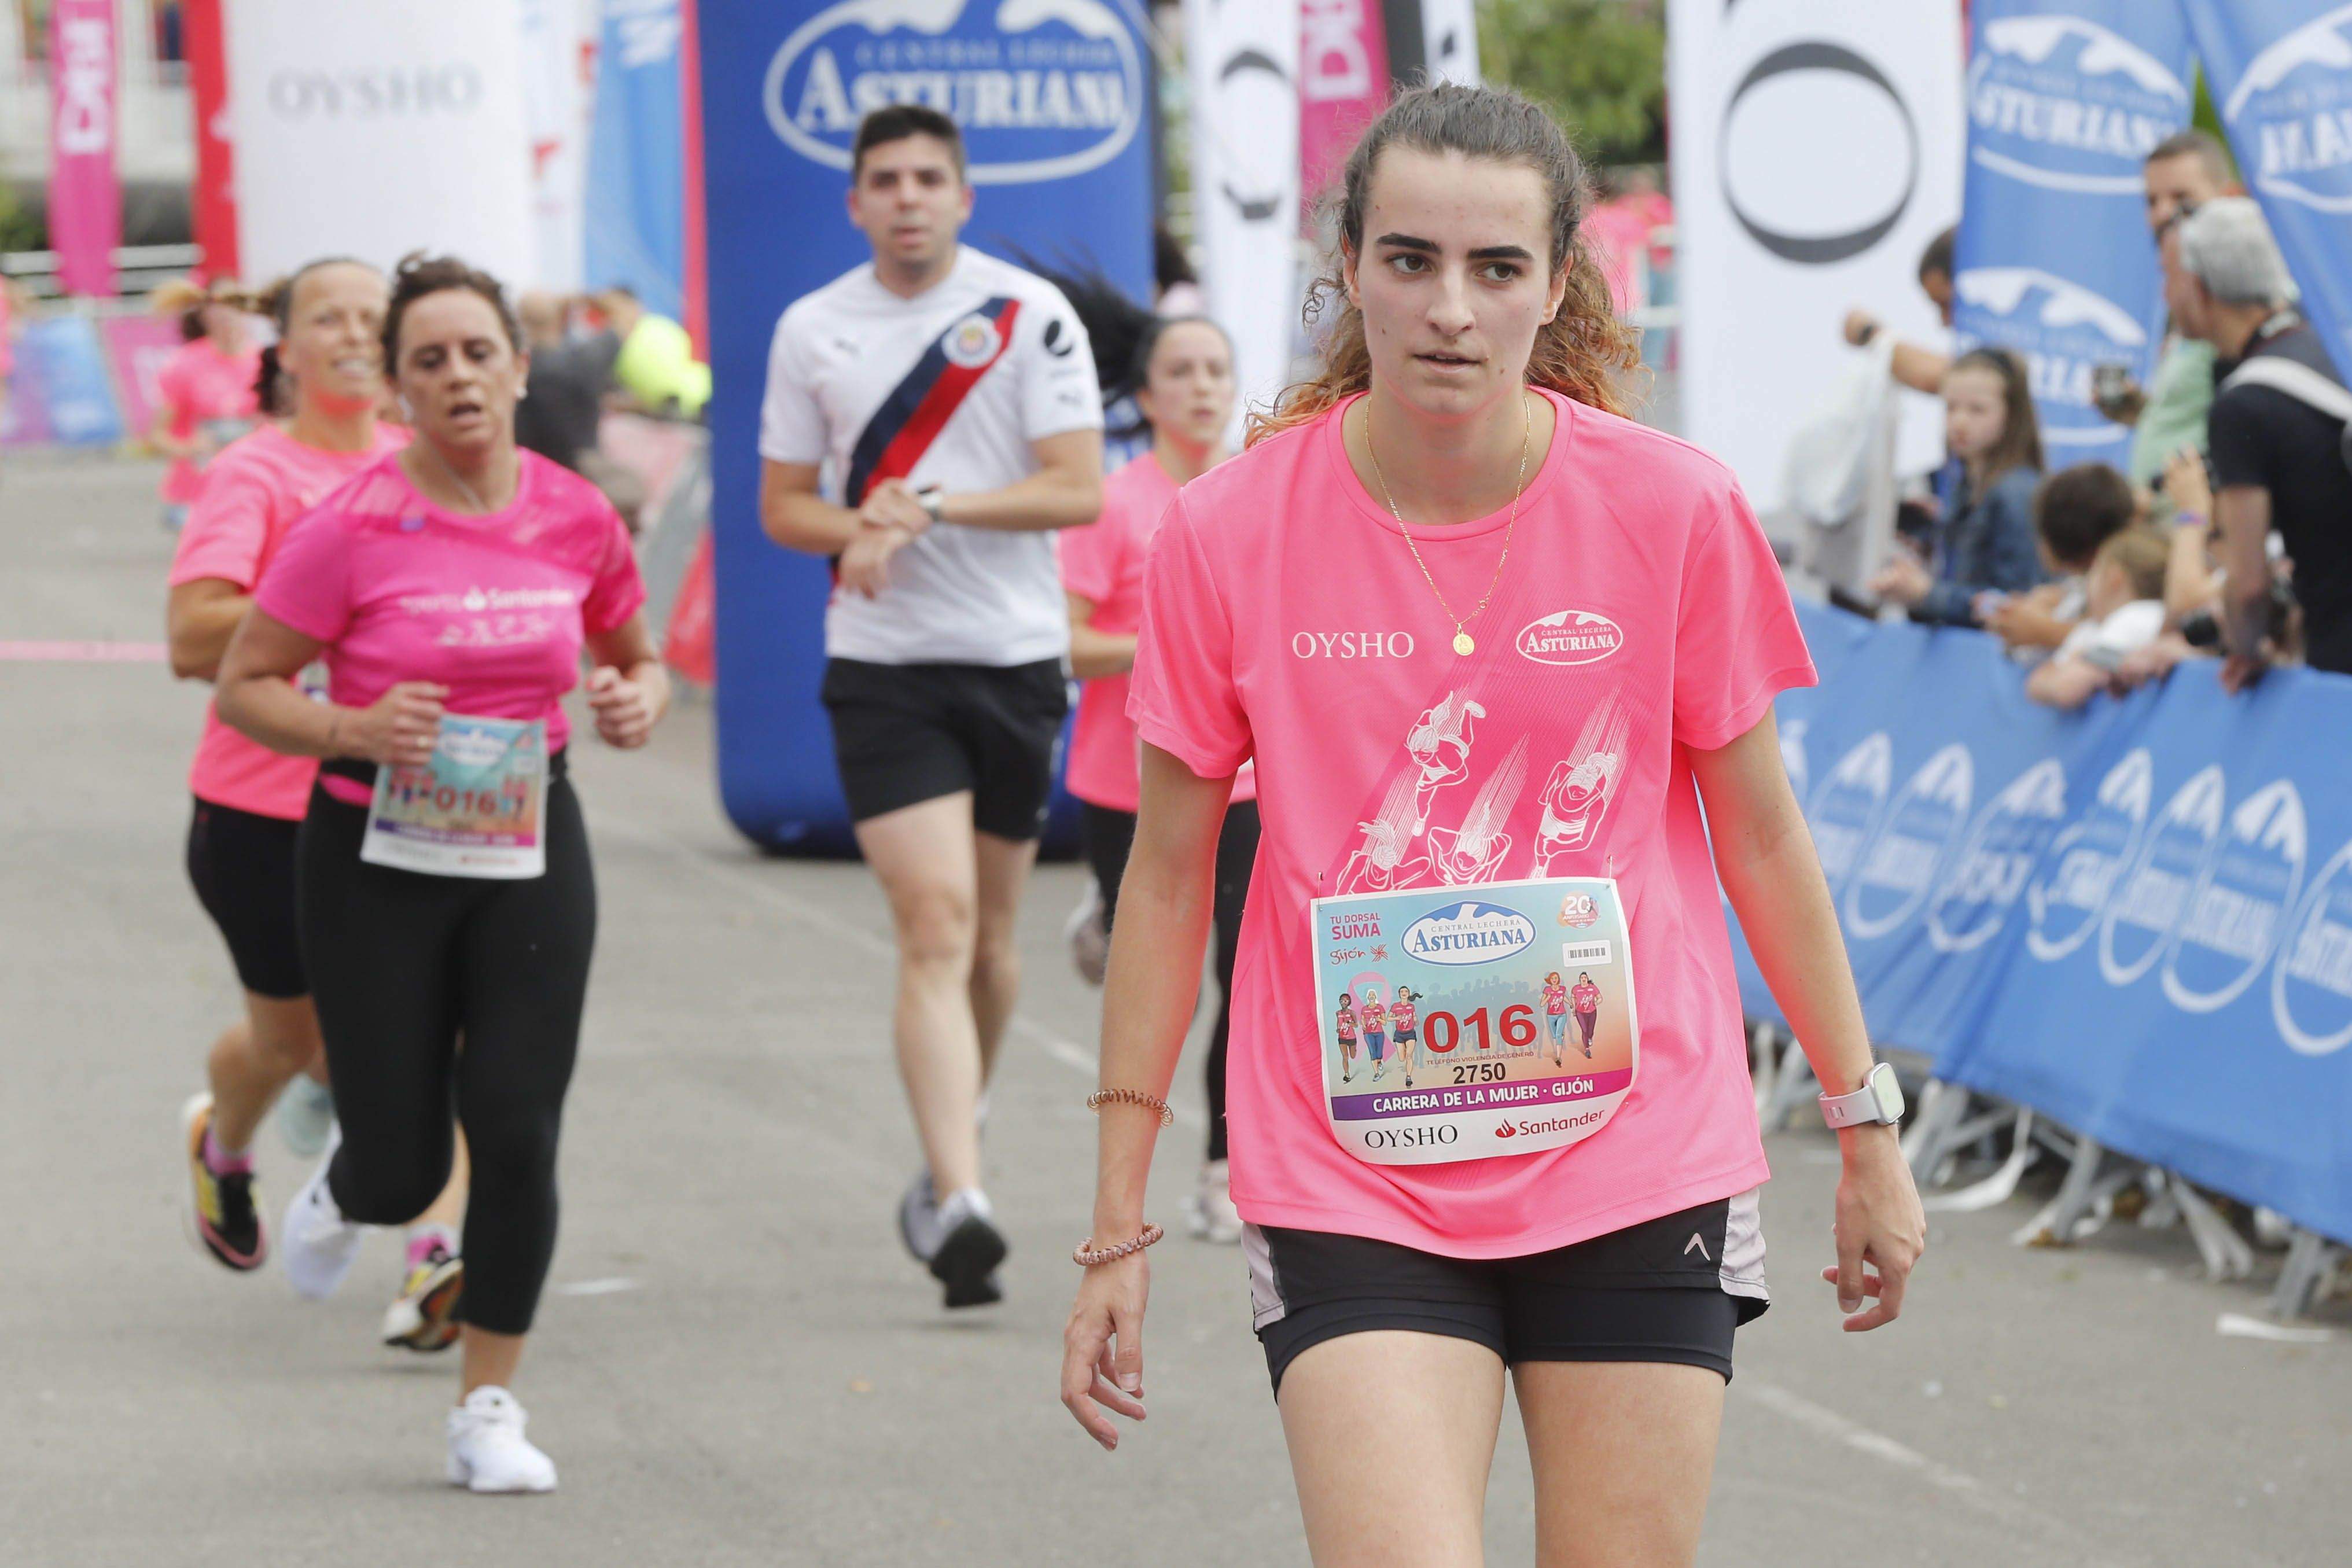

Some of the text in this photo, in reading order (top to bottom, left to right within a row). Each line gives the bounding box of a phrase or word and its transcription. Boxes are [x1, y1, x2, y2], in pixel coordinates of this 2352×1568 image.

[269, 61, 484, 117] OYSHO
[1525, 632, 1616, 653] ASTURIANA
[1579, 627, 1612, 635] LECHERA
[1292, 631, 1415, 658] OYSHO
[435, 786, 496, 816] 016
[1330, 912, 1381, 925] TU DORSAL
[1331, 922, 1381, 940] SUMA
[1431, 919, 1521, 933] CENTRAL LECHERA
[1412, 928, 1527, 954] ASTURIANA
[1423, 1004, 1537, 1054] 016
[1453, 1062, 1506, 1084] 2750
[1372, 1077, 1594, 1113] CARRERA DE LA MUJER GIJÓN
[1364, 1109, 1605, 1149] OYSHO Santander
